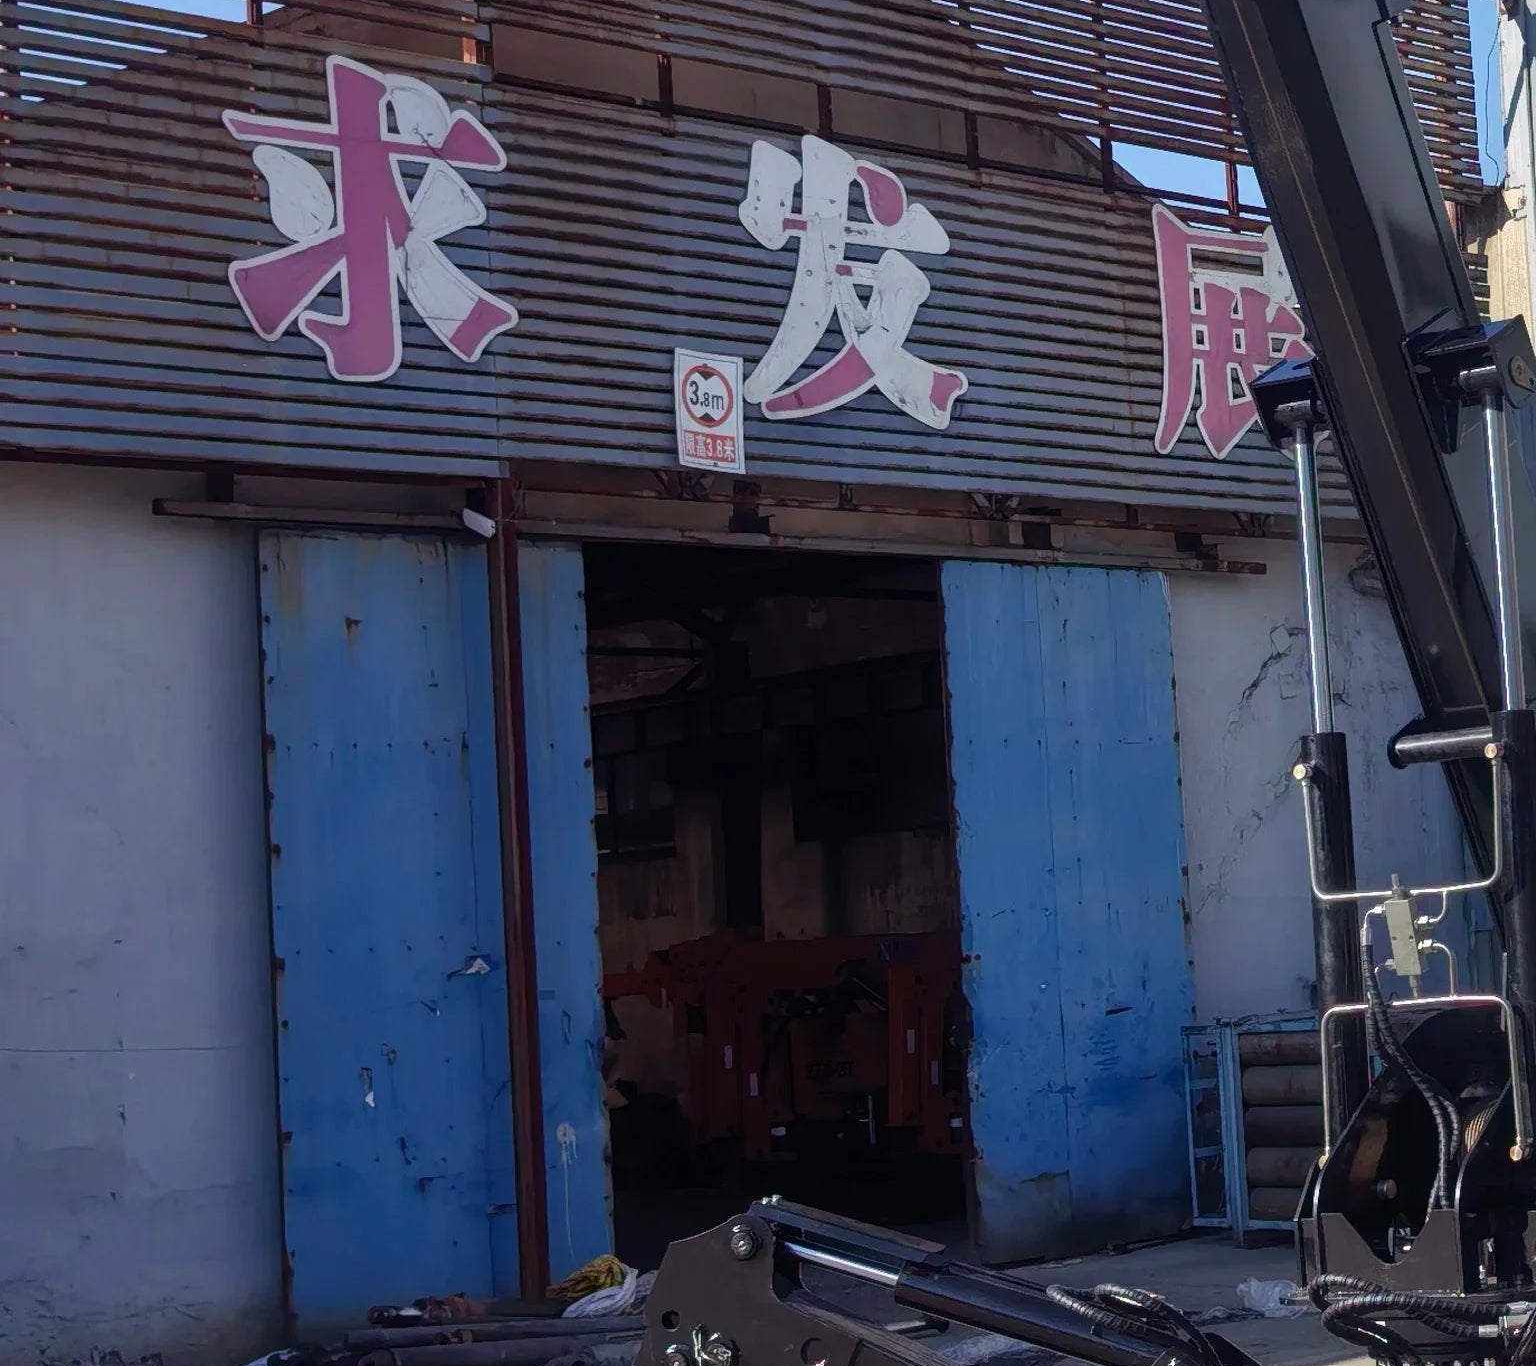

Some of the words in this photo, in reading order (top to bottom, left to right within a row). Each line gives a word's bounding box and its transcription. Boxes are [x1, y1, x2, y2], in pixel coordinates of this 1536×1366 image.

[689, 380, 724, 411] 3.8m
[685, 432, 736, 461] 限高3.8米
